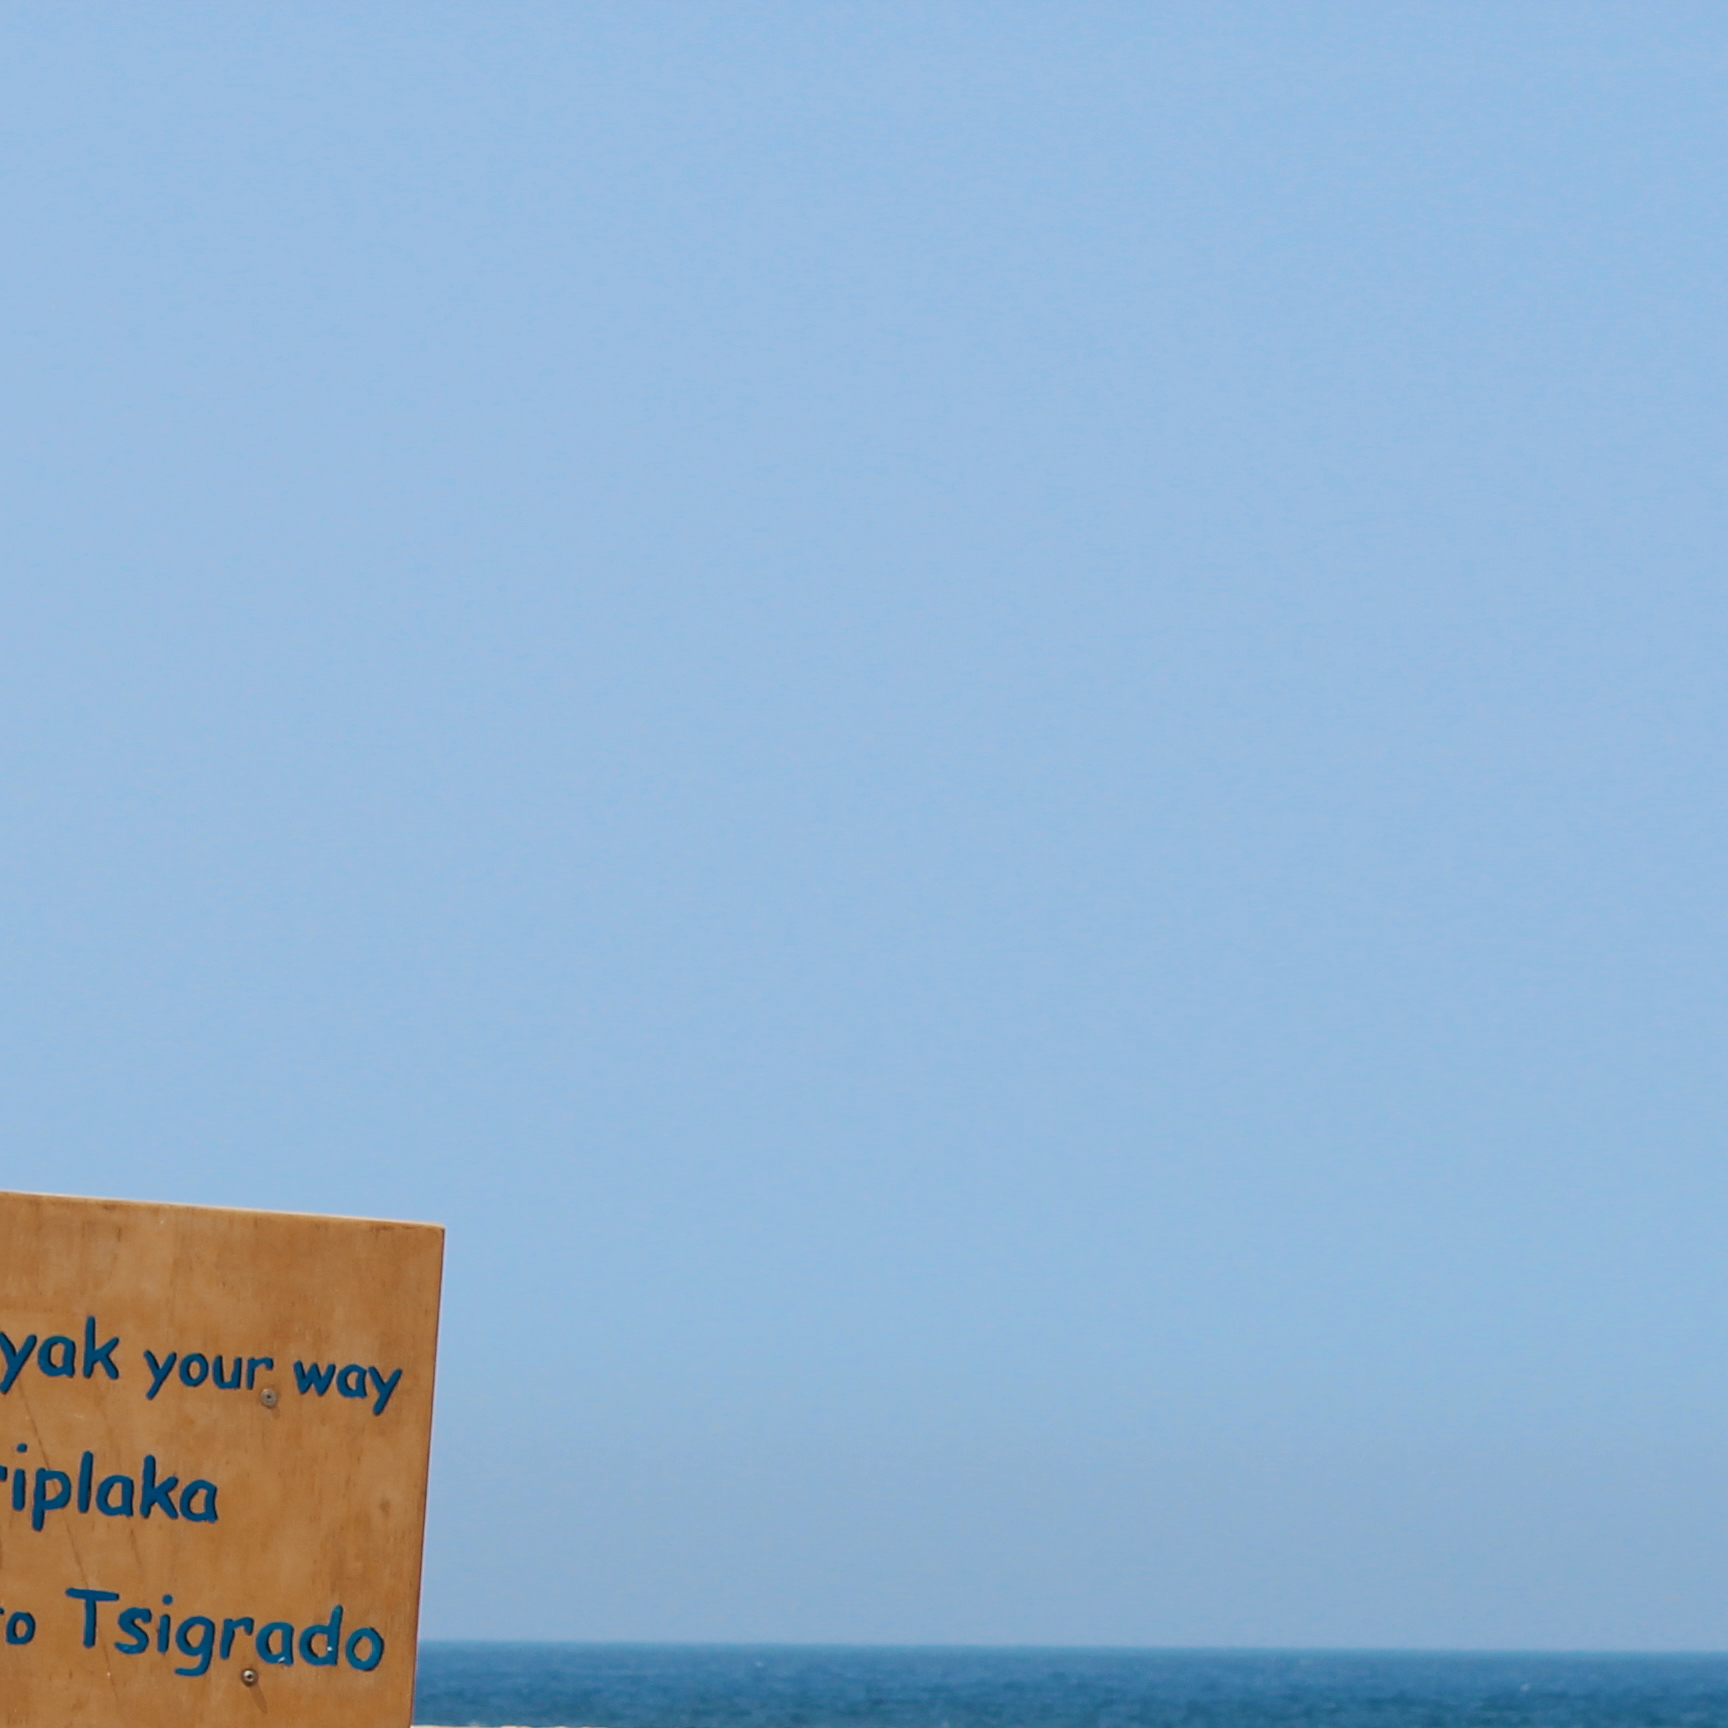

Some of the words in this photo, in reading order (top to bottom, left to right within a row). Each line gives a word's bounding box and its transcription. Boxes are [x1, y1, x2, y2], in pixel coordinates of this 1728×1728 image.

[143, 1348, 274, 1399] your
[293, 1360, 403, 1415] way
[65, 1587, 385, 1677] Tsigrado
